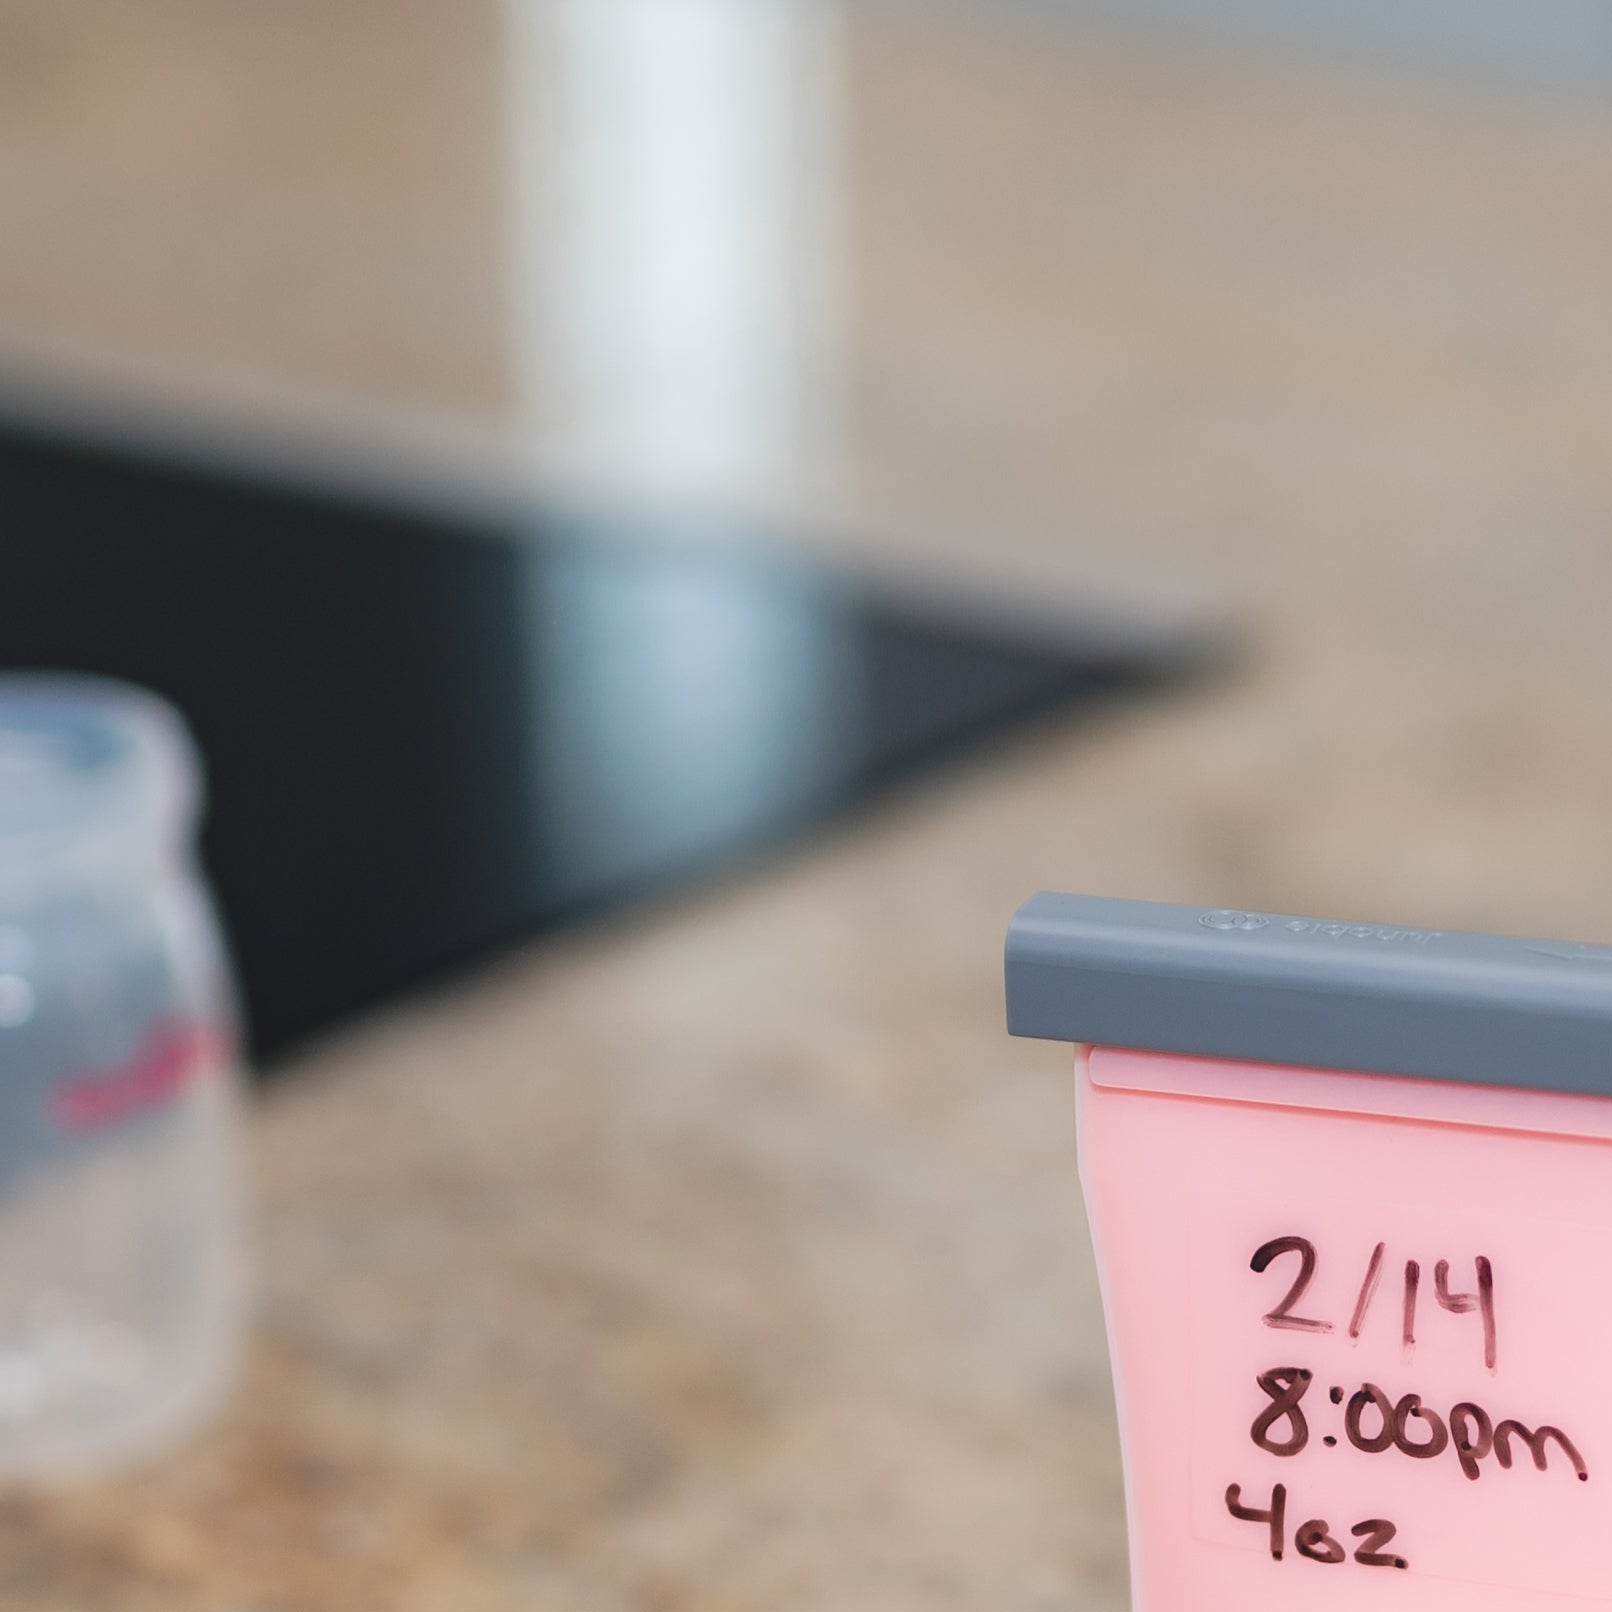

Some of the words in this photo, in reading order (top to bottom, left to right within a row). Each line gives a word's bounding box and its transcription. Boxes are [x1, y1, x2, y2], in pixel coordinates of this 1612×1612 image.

[1250, 1236, 1497, 1370] 2/14
[1251, 1367, 1588, 1481] 8:00pm
[1225, 1483, 1409, 1569] 4oz
